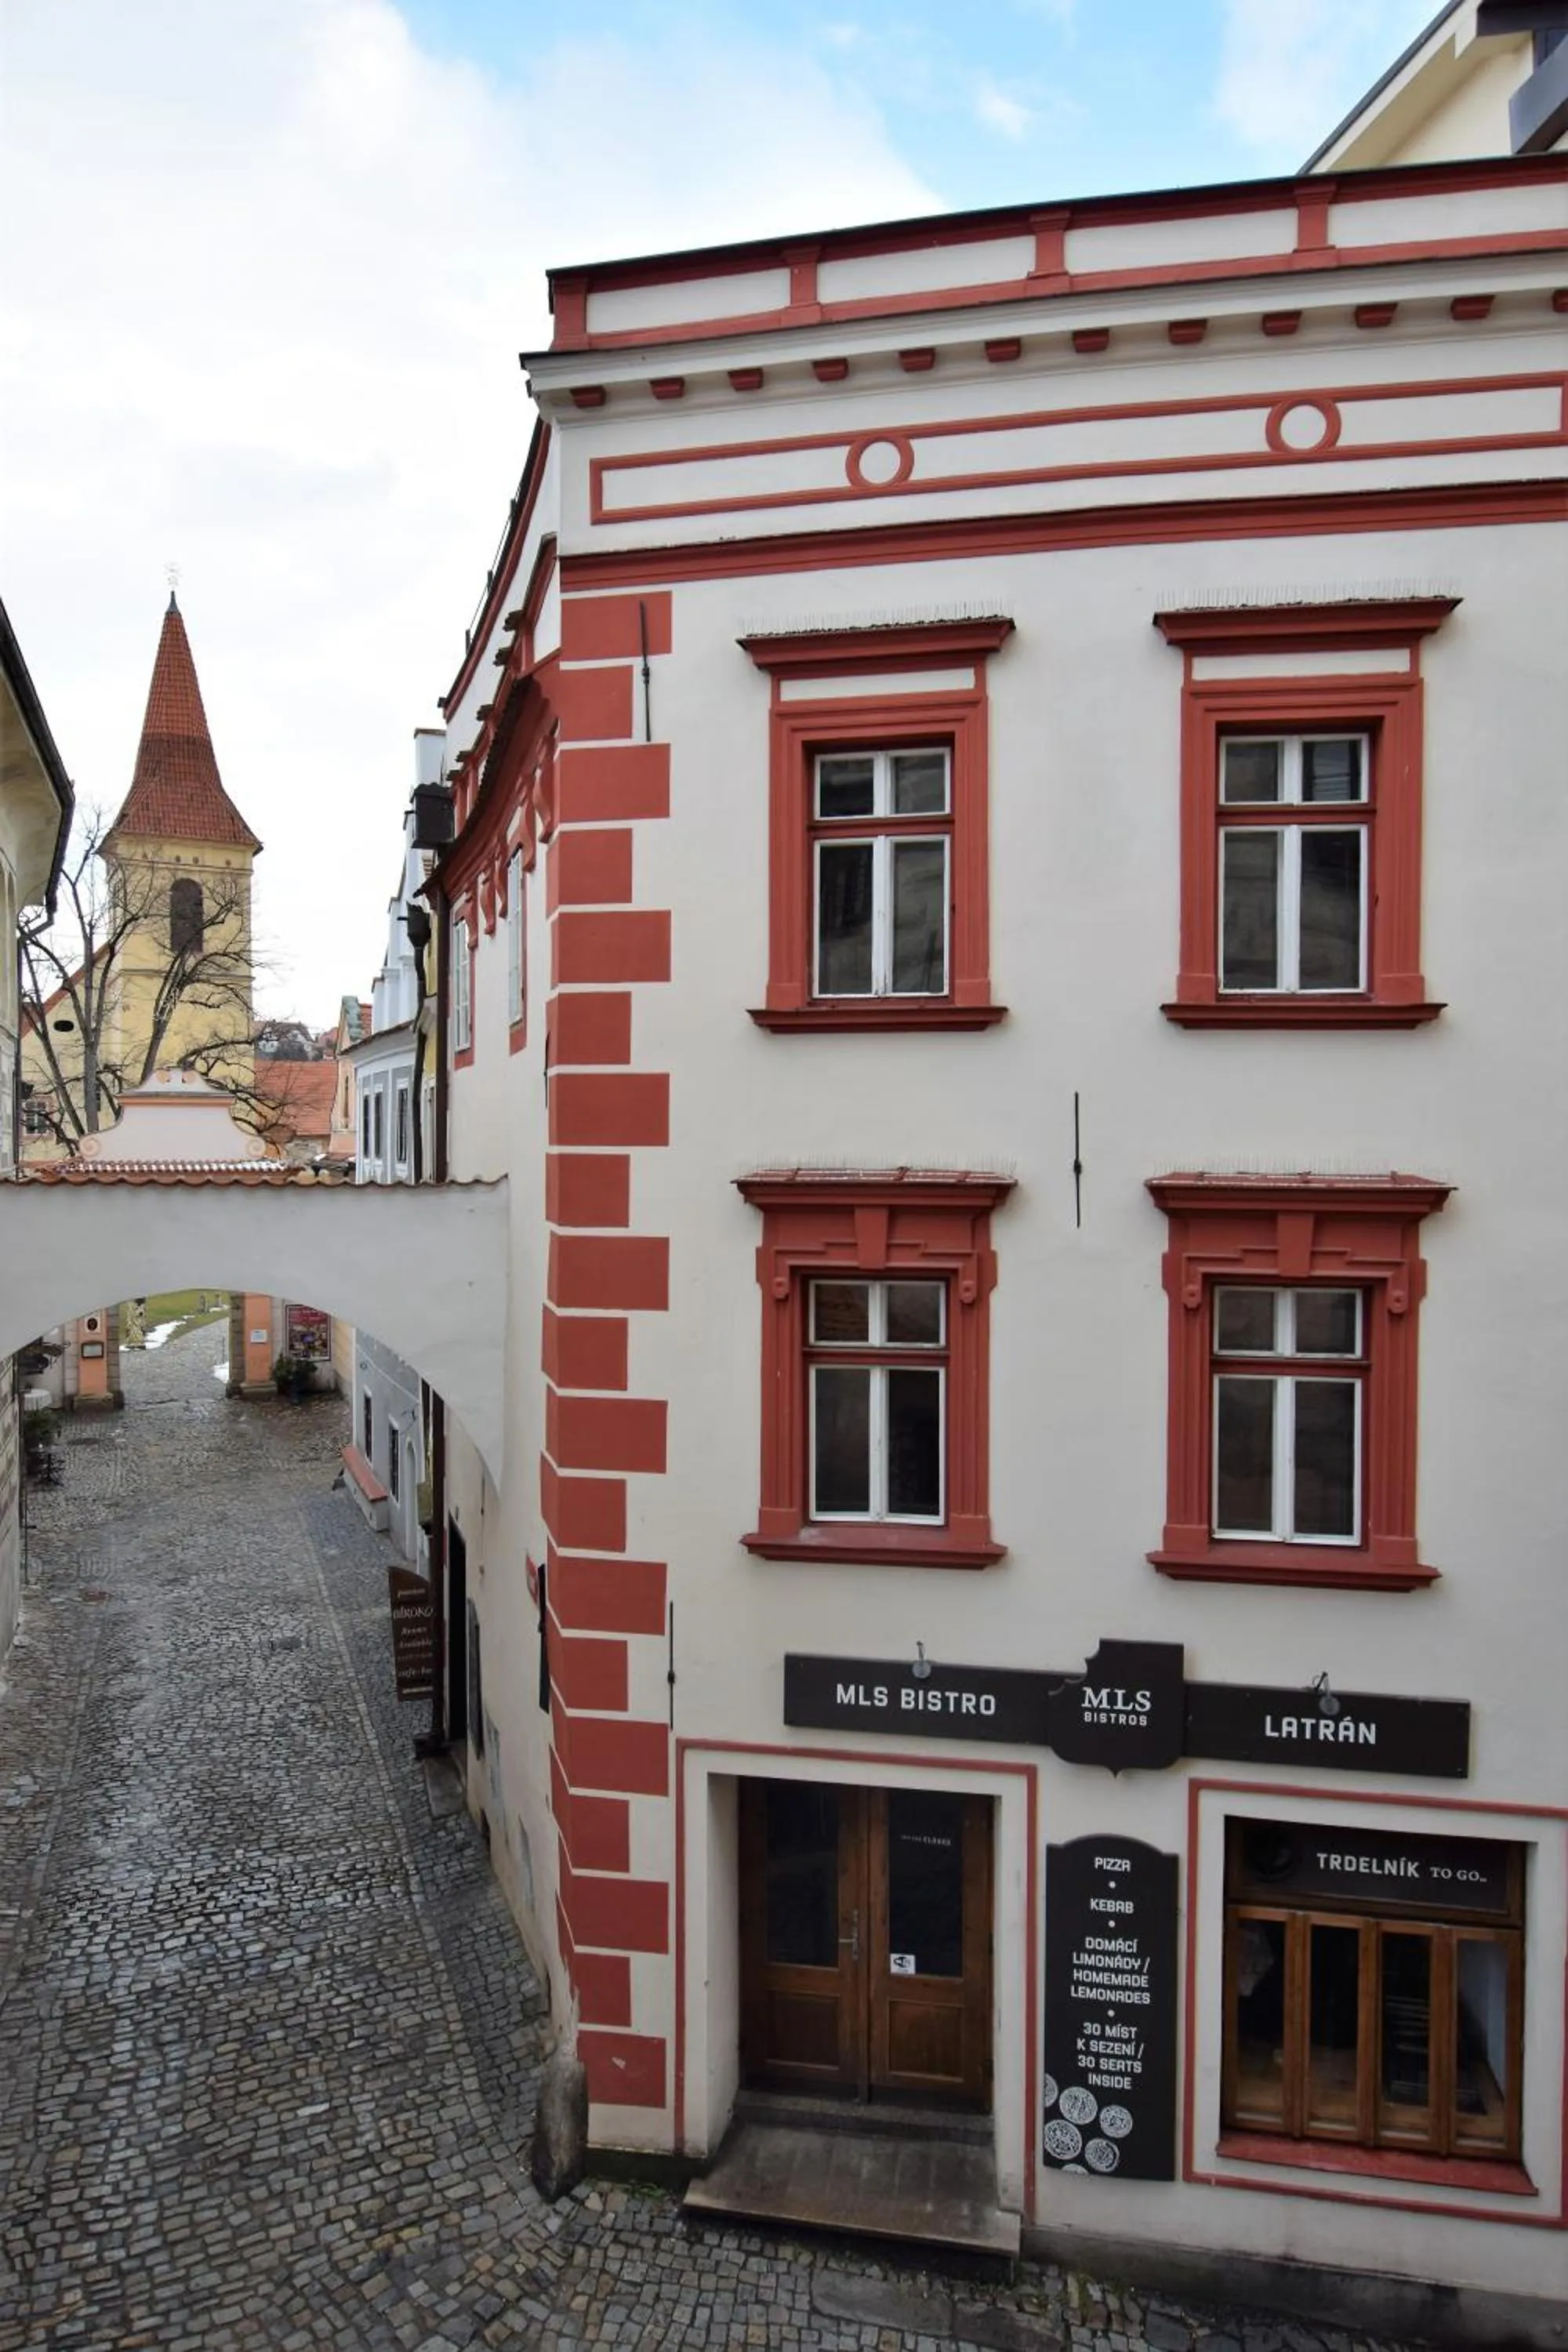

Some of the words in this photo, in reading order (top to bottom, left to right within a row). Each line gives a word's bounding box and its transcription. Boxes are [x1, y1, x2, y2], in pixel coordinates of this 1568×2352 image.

[837, 1683, 888, 1707] MLS
[901, 1689, 996, 1715] BISTRO
[1082, 1686, 1152, 1712] MLS
[1084, 1711, 1147, 1726] BISTROS
[1265, 1715, 1376, 1744] LATRÁN
[1094, 1857, 1131, 1872] PIZZA
[1316, 1853, 1420, 1878] TRDELNÍK
[1430, 1867, 1452, 1879] TO
[1090, 1897, 1134, 1914] KEBAB
[1085, 1936, 1138, 1953] DOMÁCÍ
[1073, 1951, 1141, 1970] LIMONÁDY
[1073, 1969, 1149, 1987] HOMEMADE
[1070, 1985, 1150, 2004] LEMONADES
[1083, 2022, 1101, 2035] 30
[1105, 2024, 1138, 2039] MÍST
[1076, 2038, 1086, 2051] K
[1090, 2039, 1135, 2055] SEZENÍ
[1078, 2055, 1095, 2068] 30
[1099, 2057, 1142, 2074] SEATS
[1087, 2073, 1132, 2089] INSIDE
